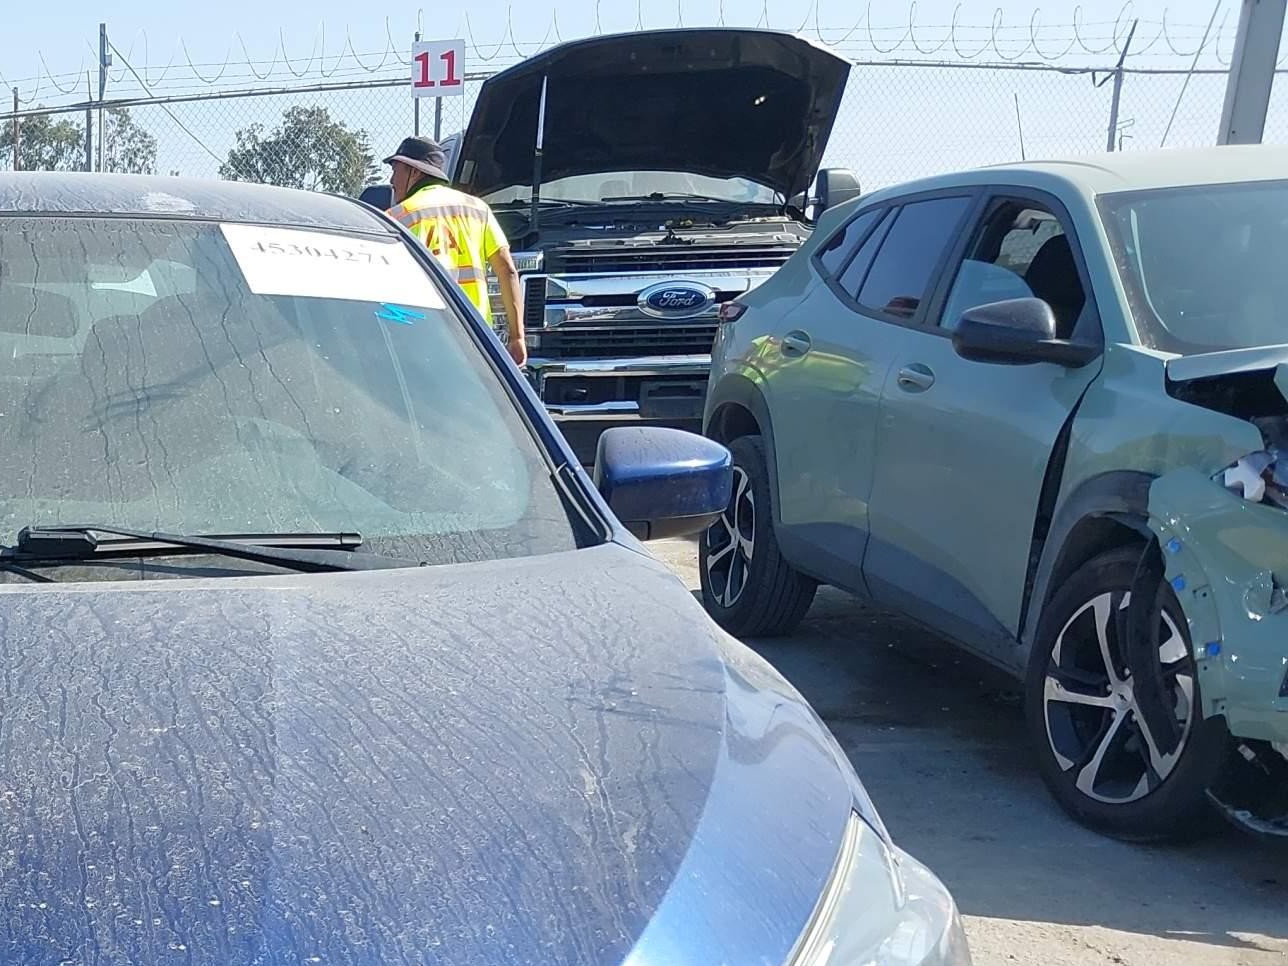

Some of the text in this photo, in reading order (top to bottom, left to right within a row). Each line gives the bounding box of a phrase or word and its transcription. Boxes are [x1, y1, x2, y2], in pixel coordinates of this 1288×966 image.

[414, 50, 461, 87] 11
[250, 240, 391, 265] 45304271
[658, 291, 696, 307] Ford
